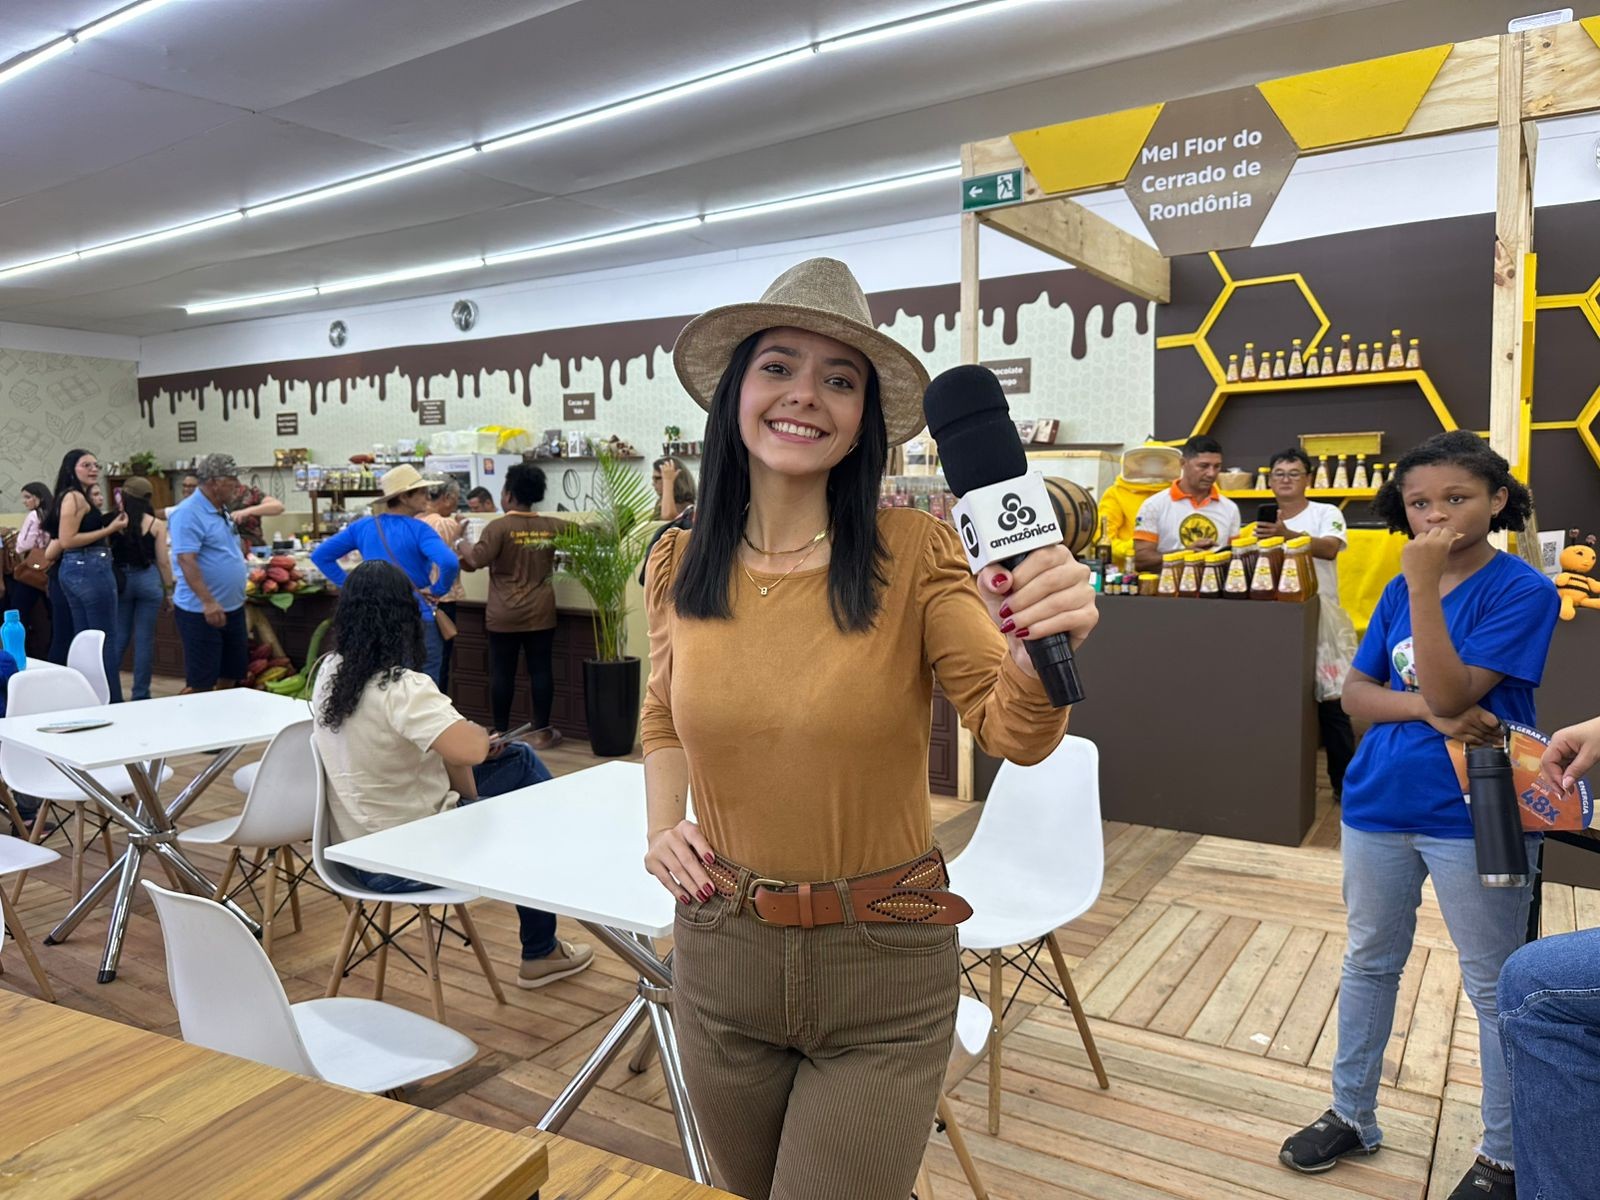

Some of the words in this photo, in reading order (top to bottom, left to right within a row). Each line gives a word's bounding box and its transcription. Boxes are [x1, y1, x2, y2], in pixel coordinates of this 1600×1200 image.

[1141, 142, 1178, 165] Mel
[1185, 136, 1227, 157] Flor
[1233, 129, 1262, 149] do
[1141, 165, 1226, 193] Cerrado
[1233, 160, 1262, 179] de
[1149, 191, 1252, 221] Rondônia
[989, 521, 1057, 549] amazônica
[1516, 725, 1542, 740] GERAR
[1578, 780, 1589, 815] ENERGIA
